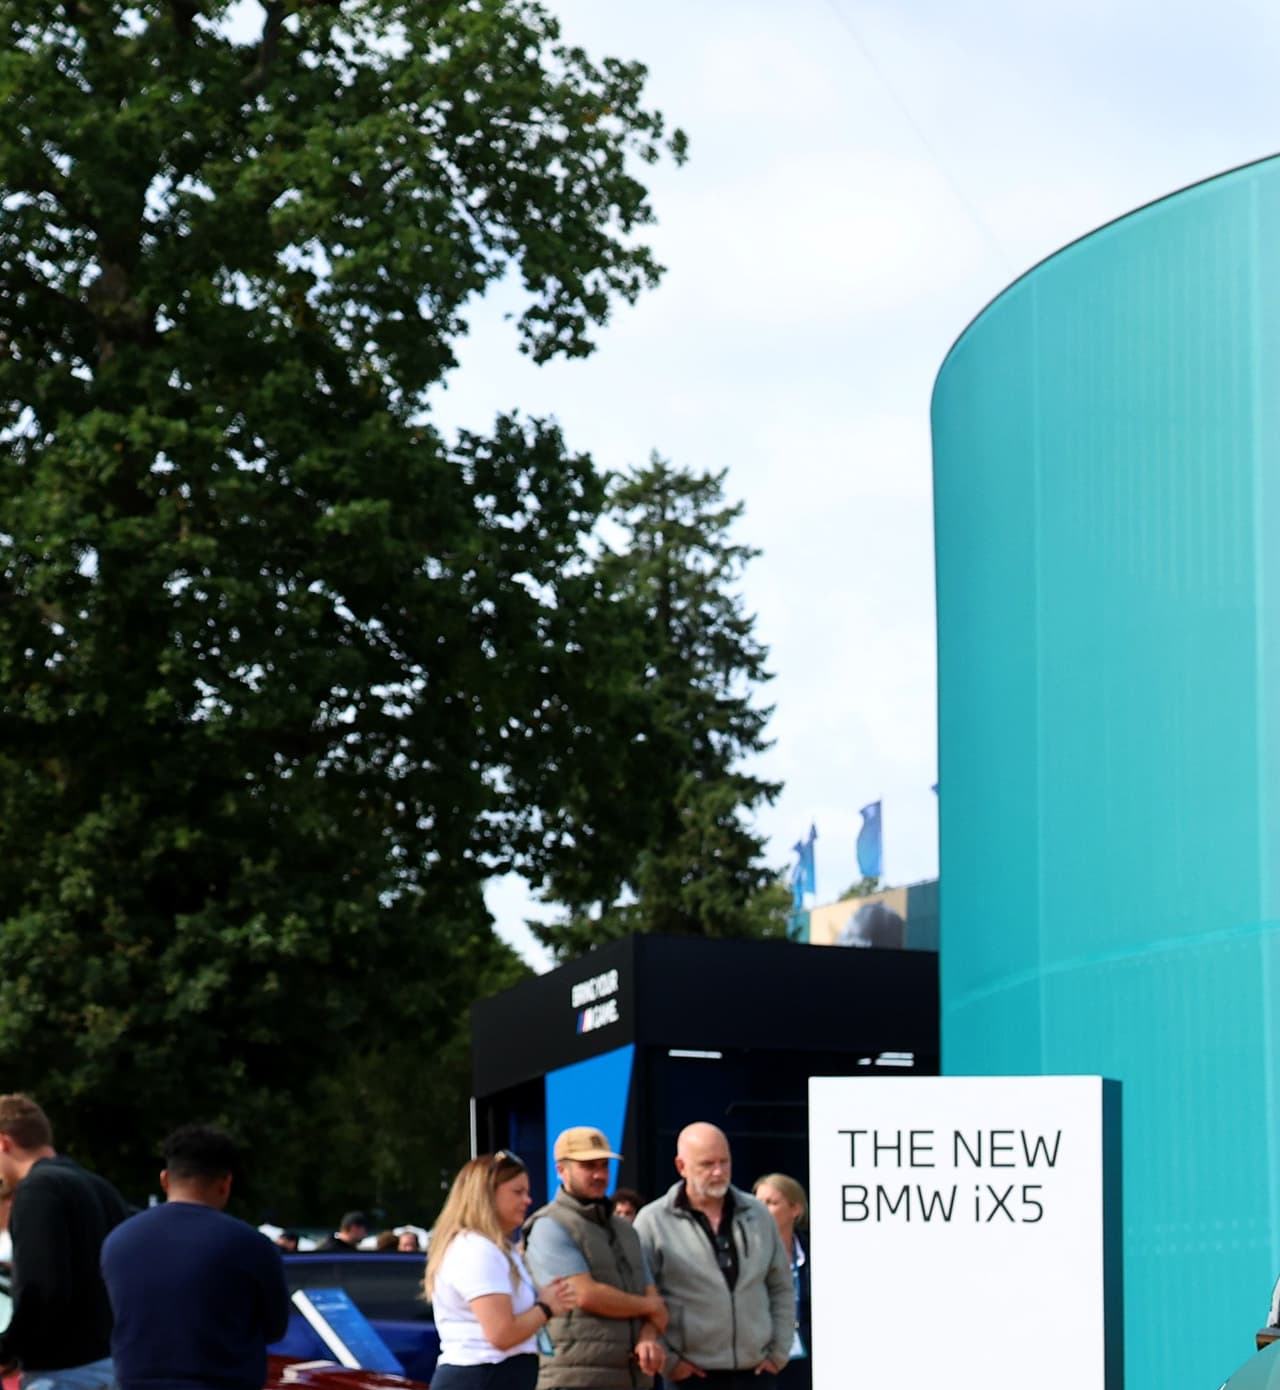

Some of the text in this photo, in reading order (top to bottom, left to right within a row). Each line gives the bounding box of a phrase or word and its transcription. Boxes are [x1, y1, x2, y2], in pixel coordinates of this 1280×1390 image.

[838, 1130, 1062, 1168] THE NEW
[841, 1184, 1043, 1222] BMW iX5
